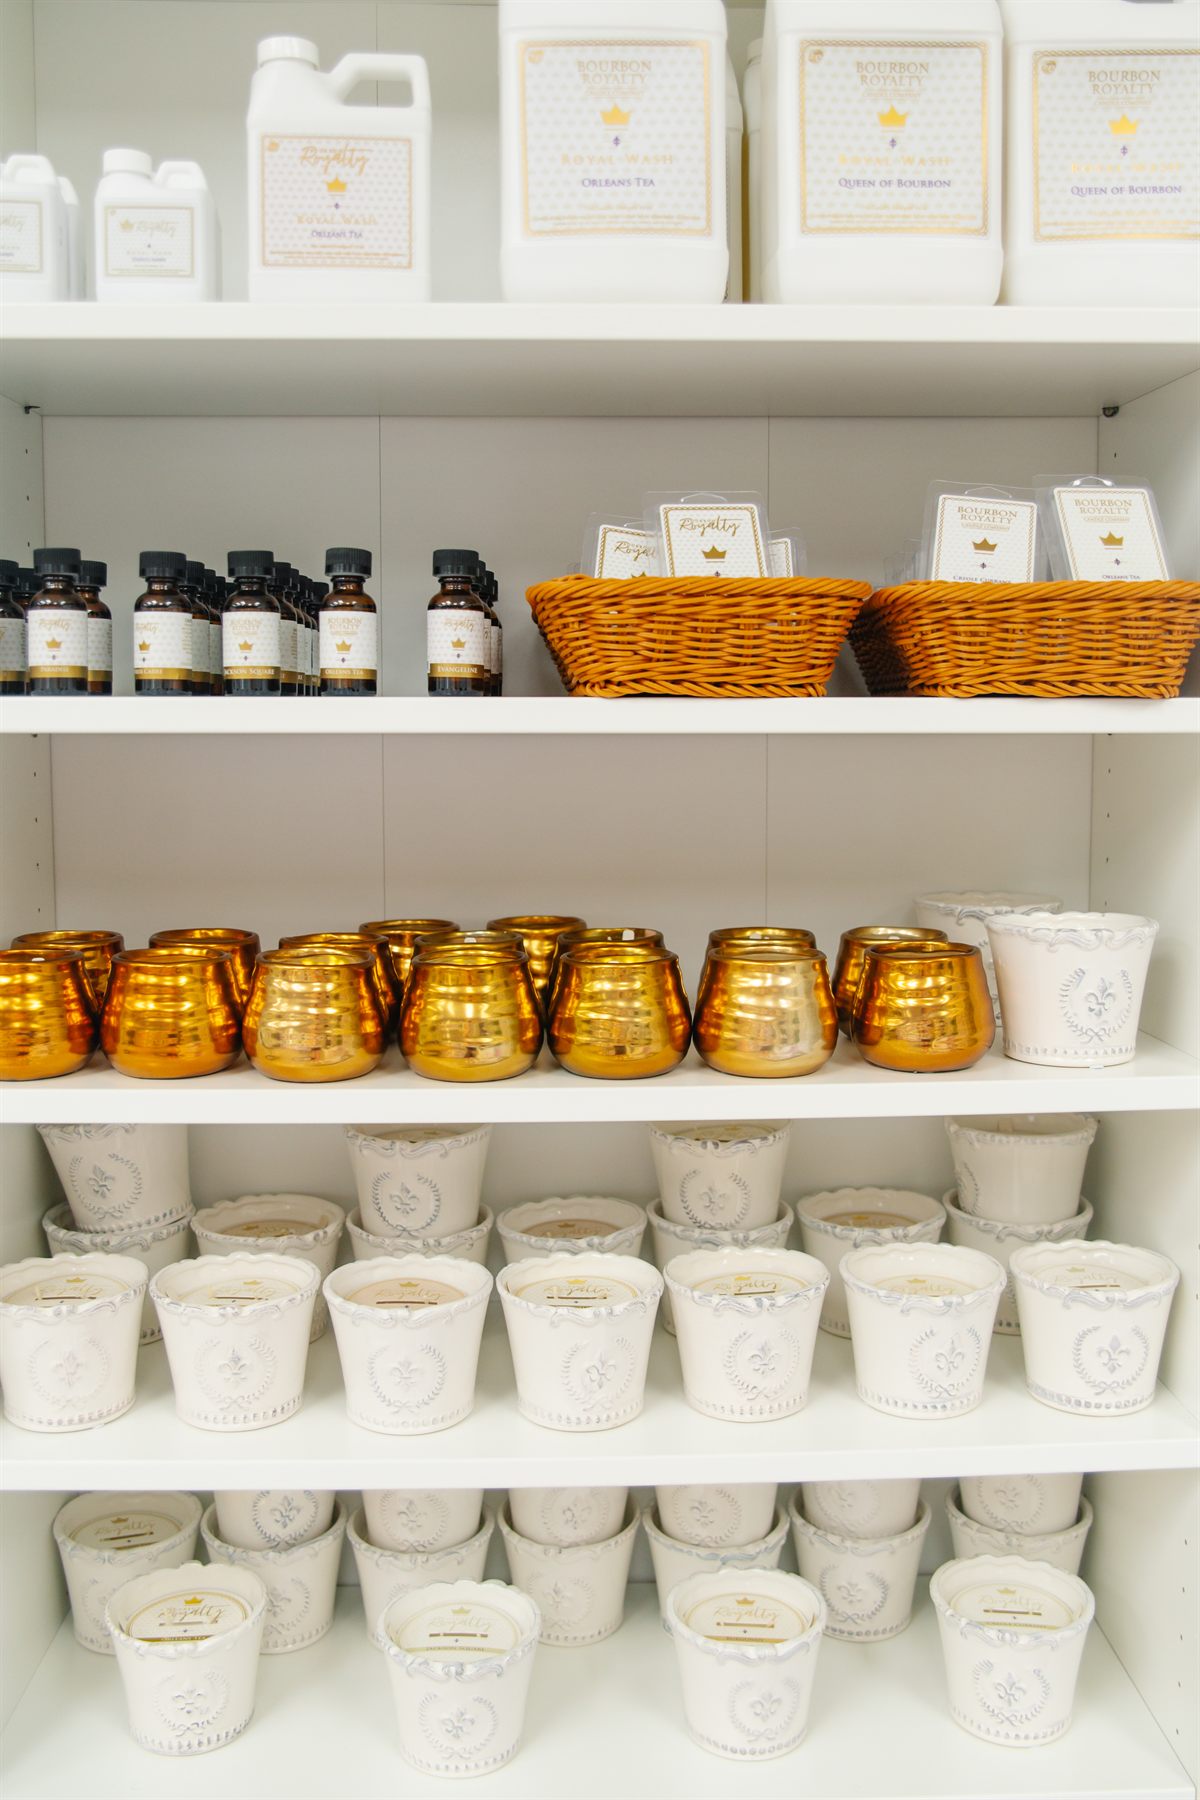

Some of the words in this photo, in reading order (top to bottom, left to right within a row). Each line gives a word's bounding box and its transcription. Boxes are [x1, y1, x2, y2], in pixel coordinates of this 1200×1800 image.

[577, 60, 652, 73] BOURBON
[856, 61, 929, 74] BOURBON
[582, 74, 646, 85] ROYALTY
[860, 75, 924, 87] ROYALTY
[1088, 70, 1160, 82] BOURBON
[1092, 84, 1154, 95] ROYALTY
[300, 143, 374, 175] Royalty
[1074, 498, 1132, 507] BOURBON
[957, 505, 1018, 518] BOURBON
[1080, 506, 1129, 515] ROYALTY
[960, 513, 1014, 525] ROYALTY
[679, 515, 744, 537] Royalty
[438, 666, 478, 674] EVANGELINE
